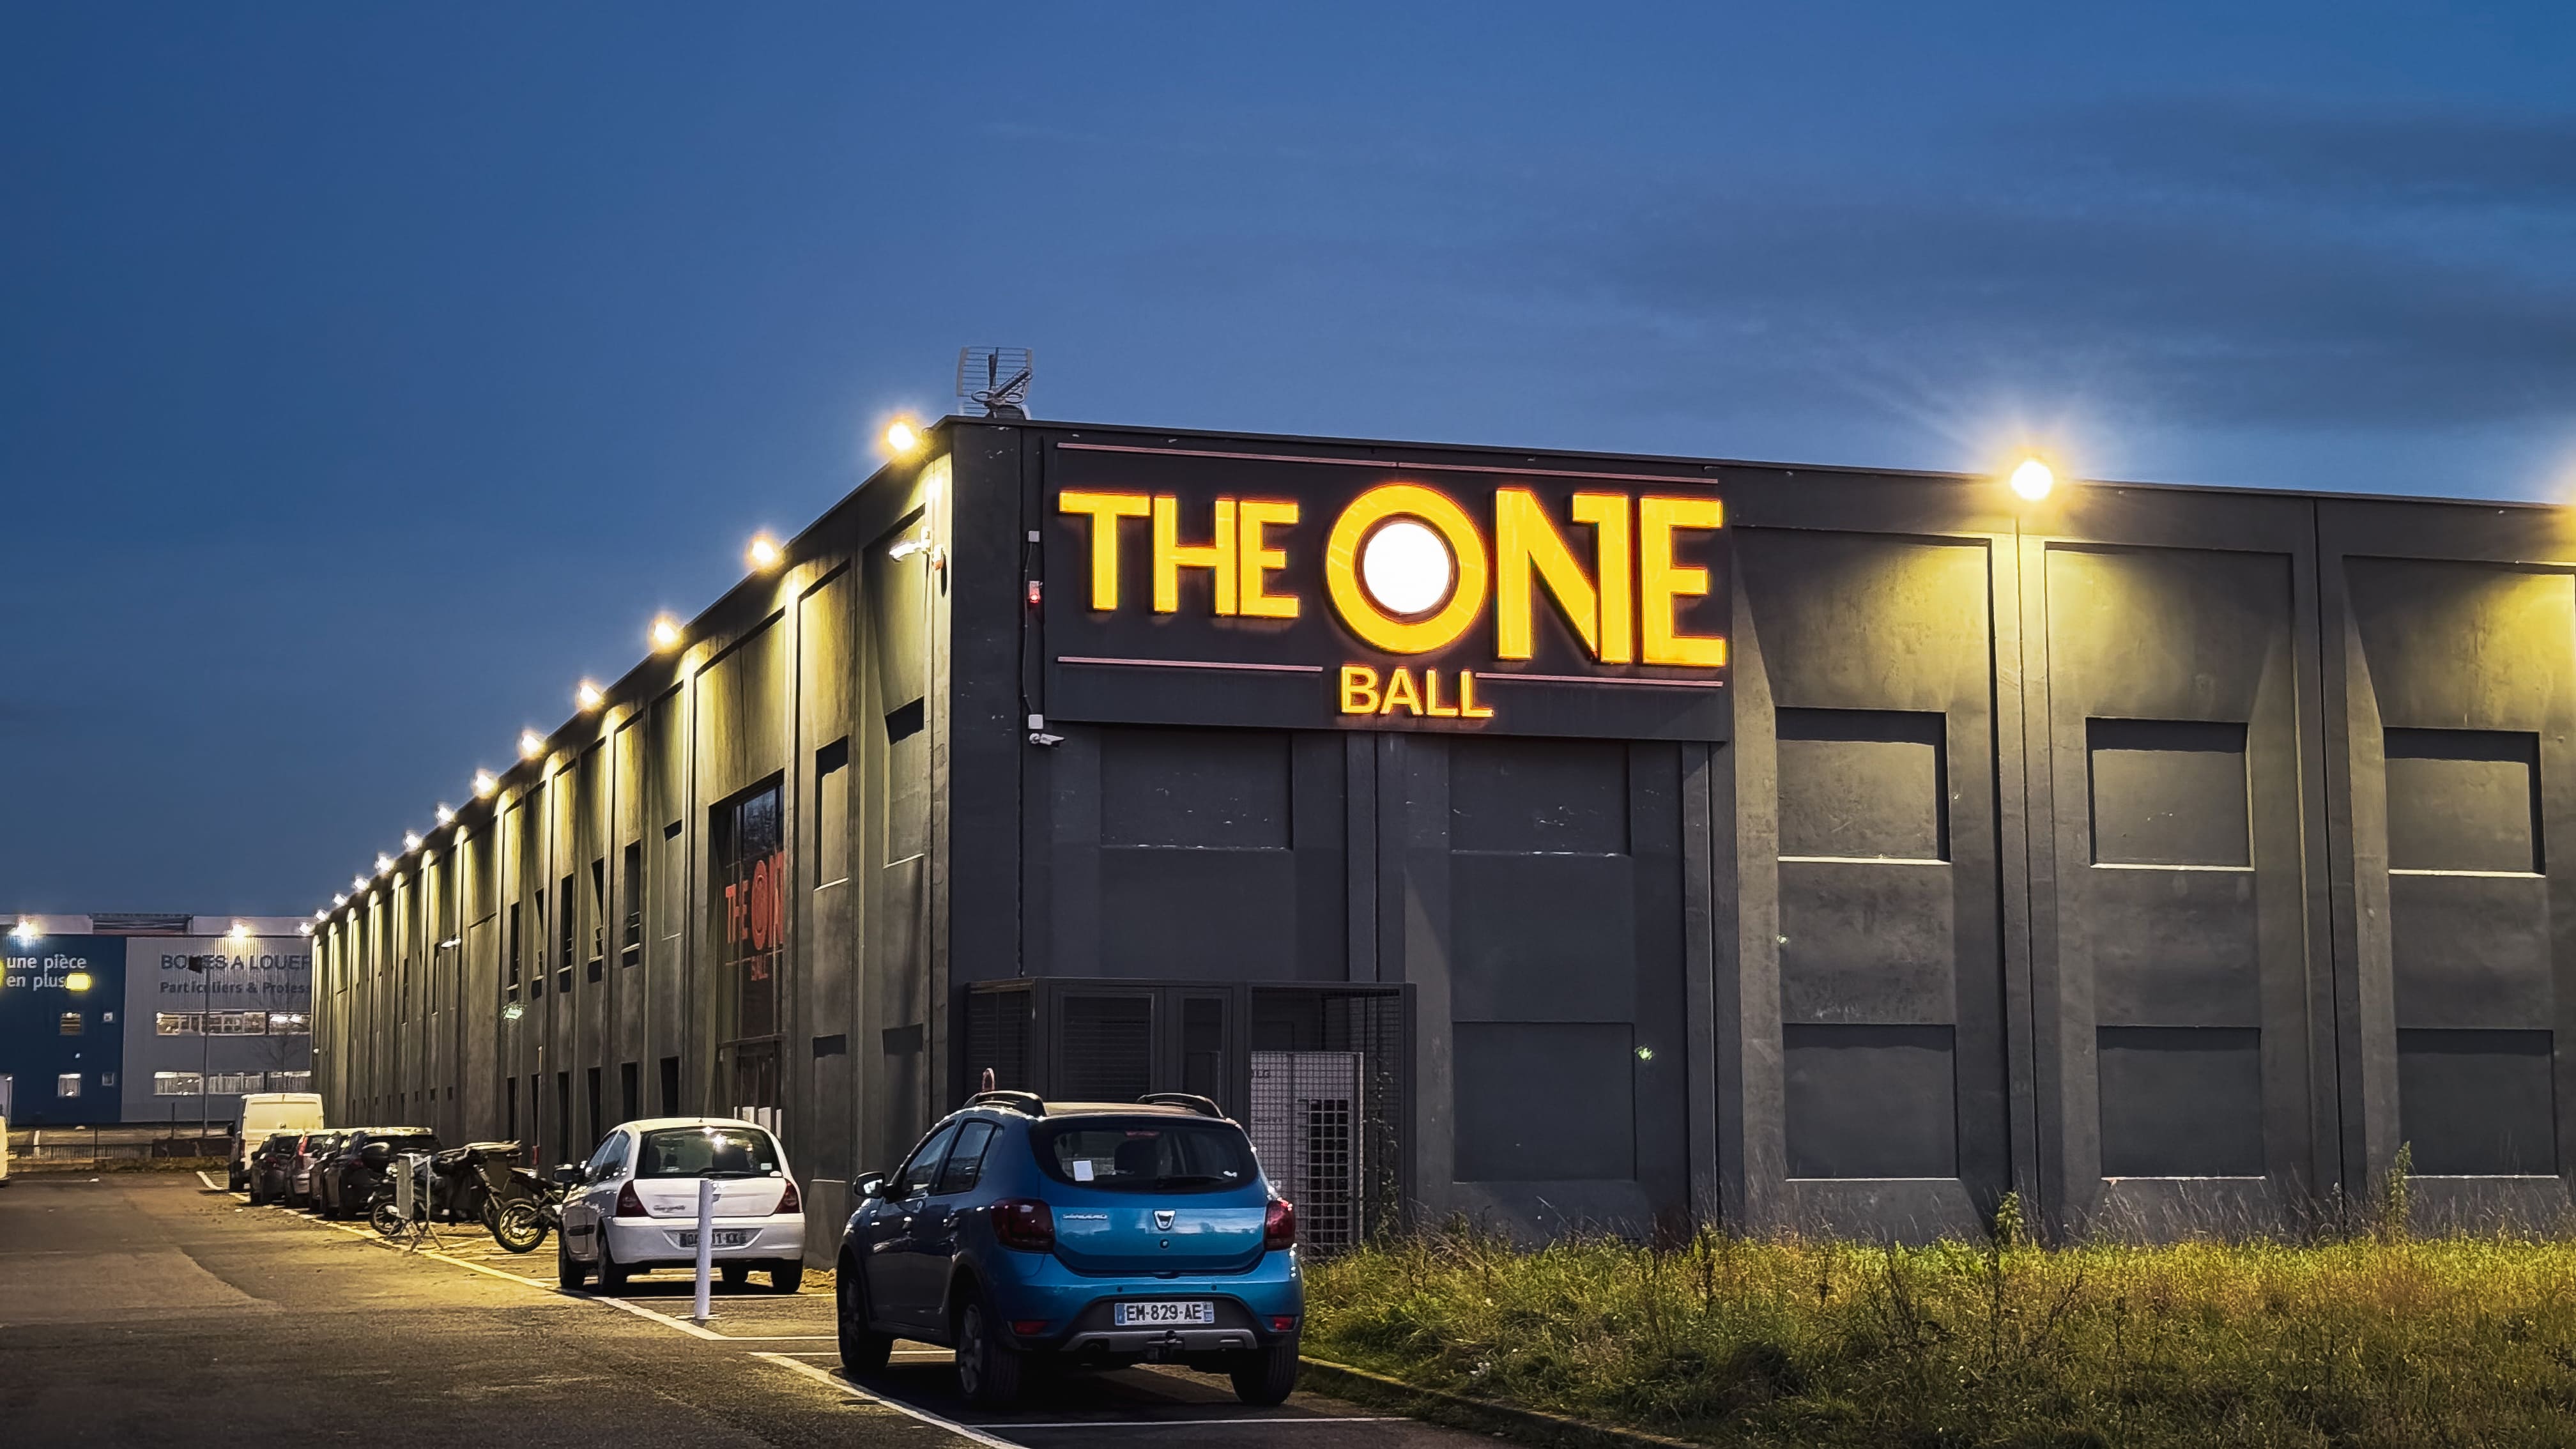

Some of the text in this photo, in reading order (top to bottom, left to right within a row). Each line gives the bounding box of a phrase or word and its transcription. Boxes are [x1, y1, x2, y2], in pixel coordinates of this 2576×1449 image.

[1059, 484, 1726, 667] THE ONE
[1340, 666, 1494, 717] BALL
[7, 954, 87, 972] une pièce
[161, 955, 227, 969] BOES
[231, 956, 244, 970] A
[6, 972, 66, 991] en plus
[160, 982, 242, 993] Particliers
[247, 982, 256, 993] &
[1126, 1304, 1202, 1321] EM-829-AE
